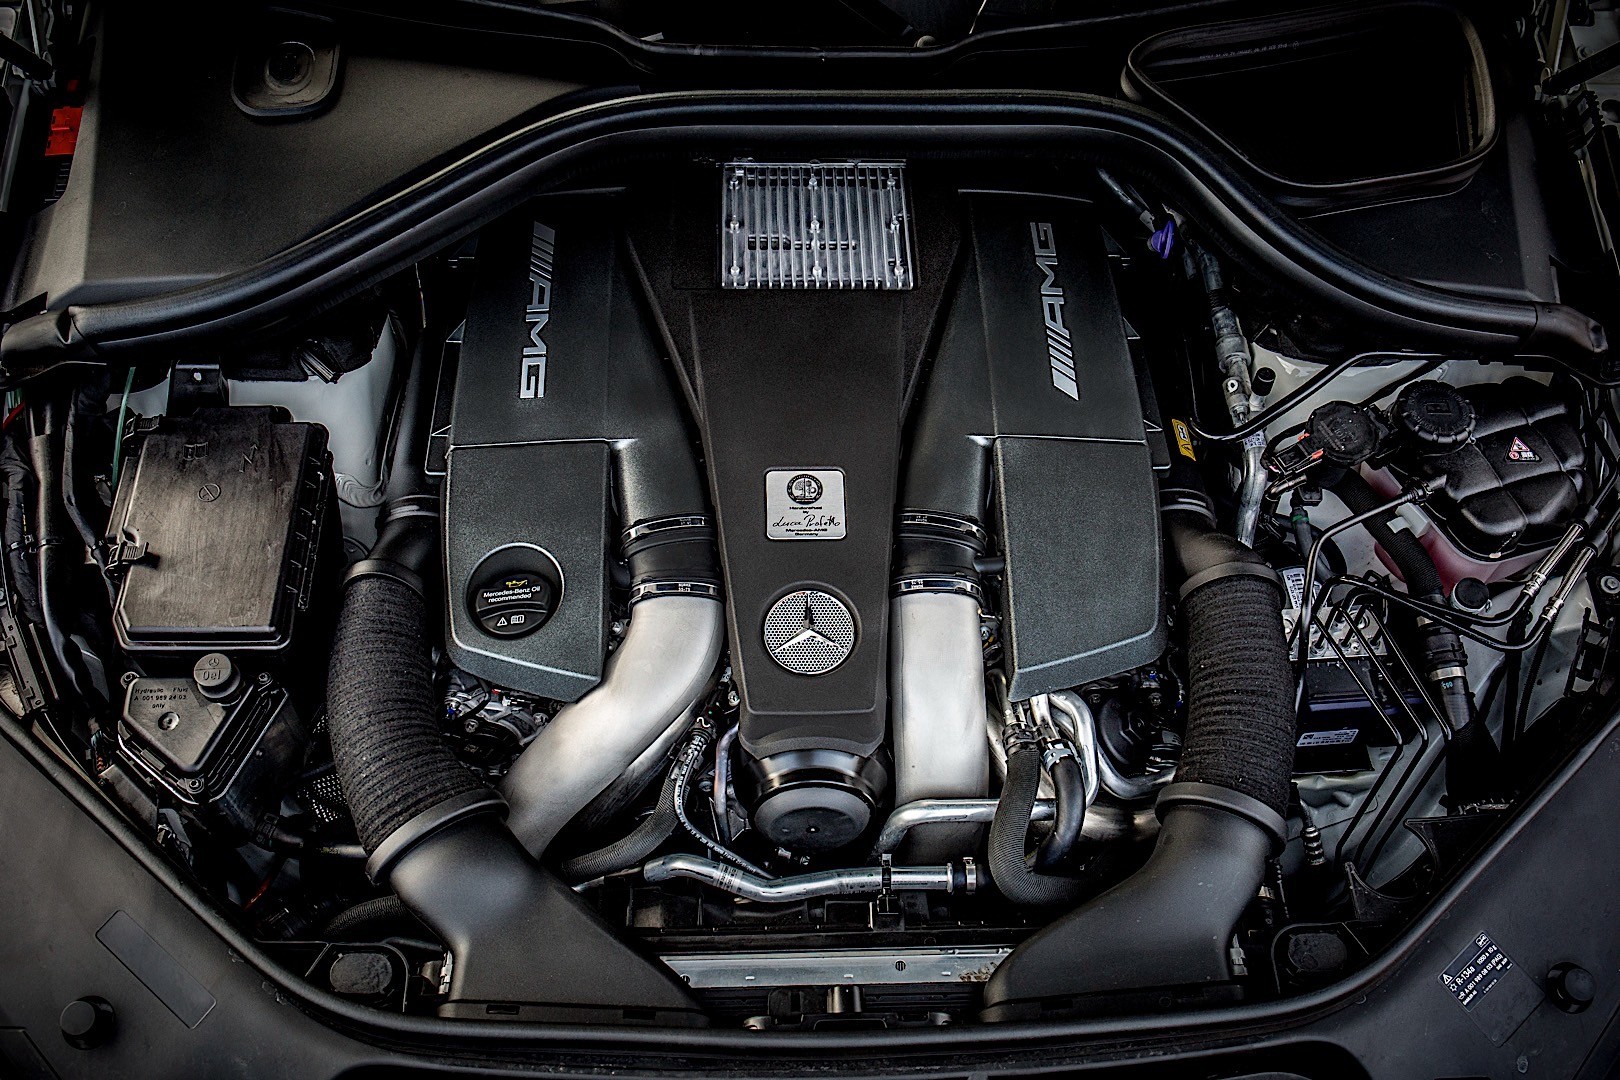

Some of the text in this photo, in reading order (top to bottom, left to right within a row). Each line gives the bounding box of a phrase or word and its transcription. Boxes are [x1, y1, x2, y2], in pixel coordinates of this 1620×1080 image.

[1030, 222, 1070, 339] AMG
[520, 272, 551, 399] AMG
[483, 587, 530, 598] Mercedes-Benz
[488, 593, 532, 603] recommended
[1456, 966, 1475, 985] R-134a
